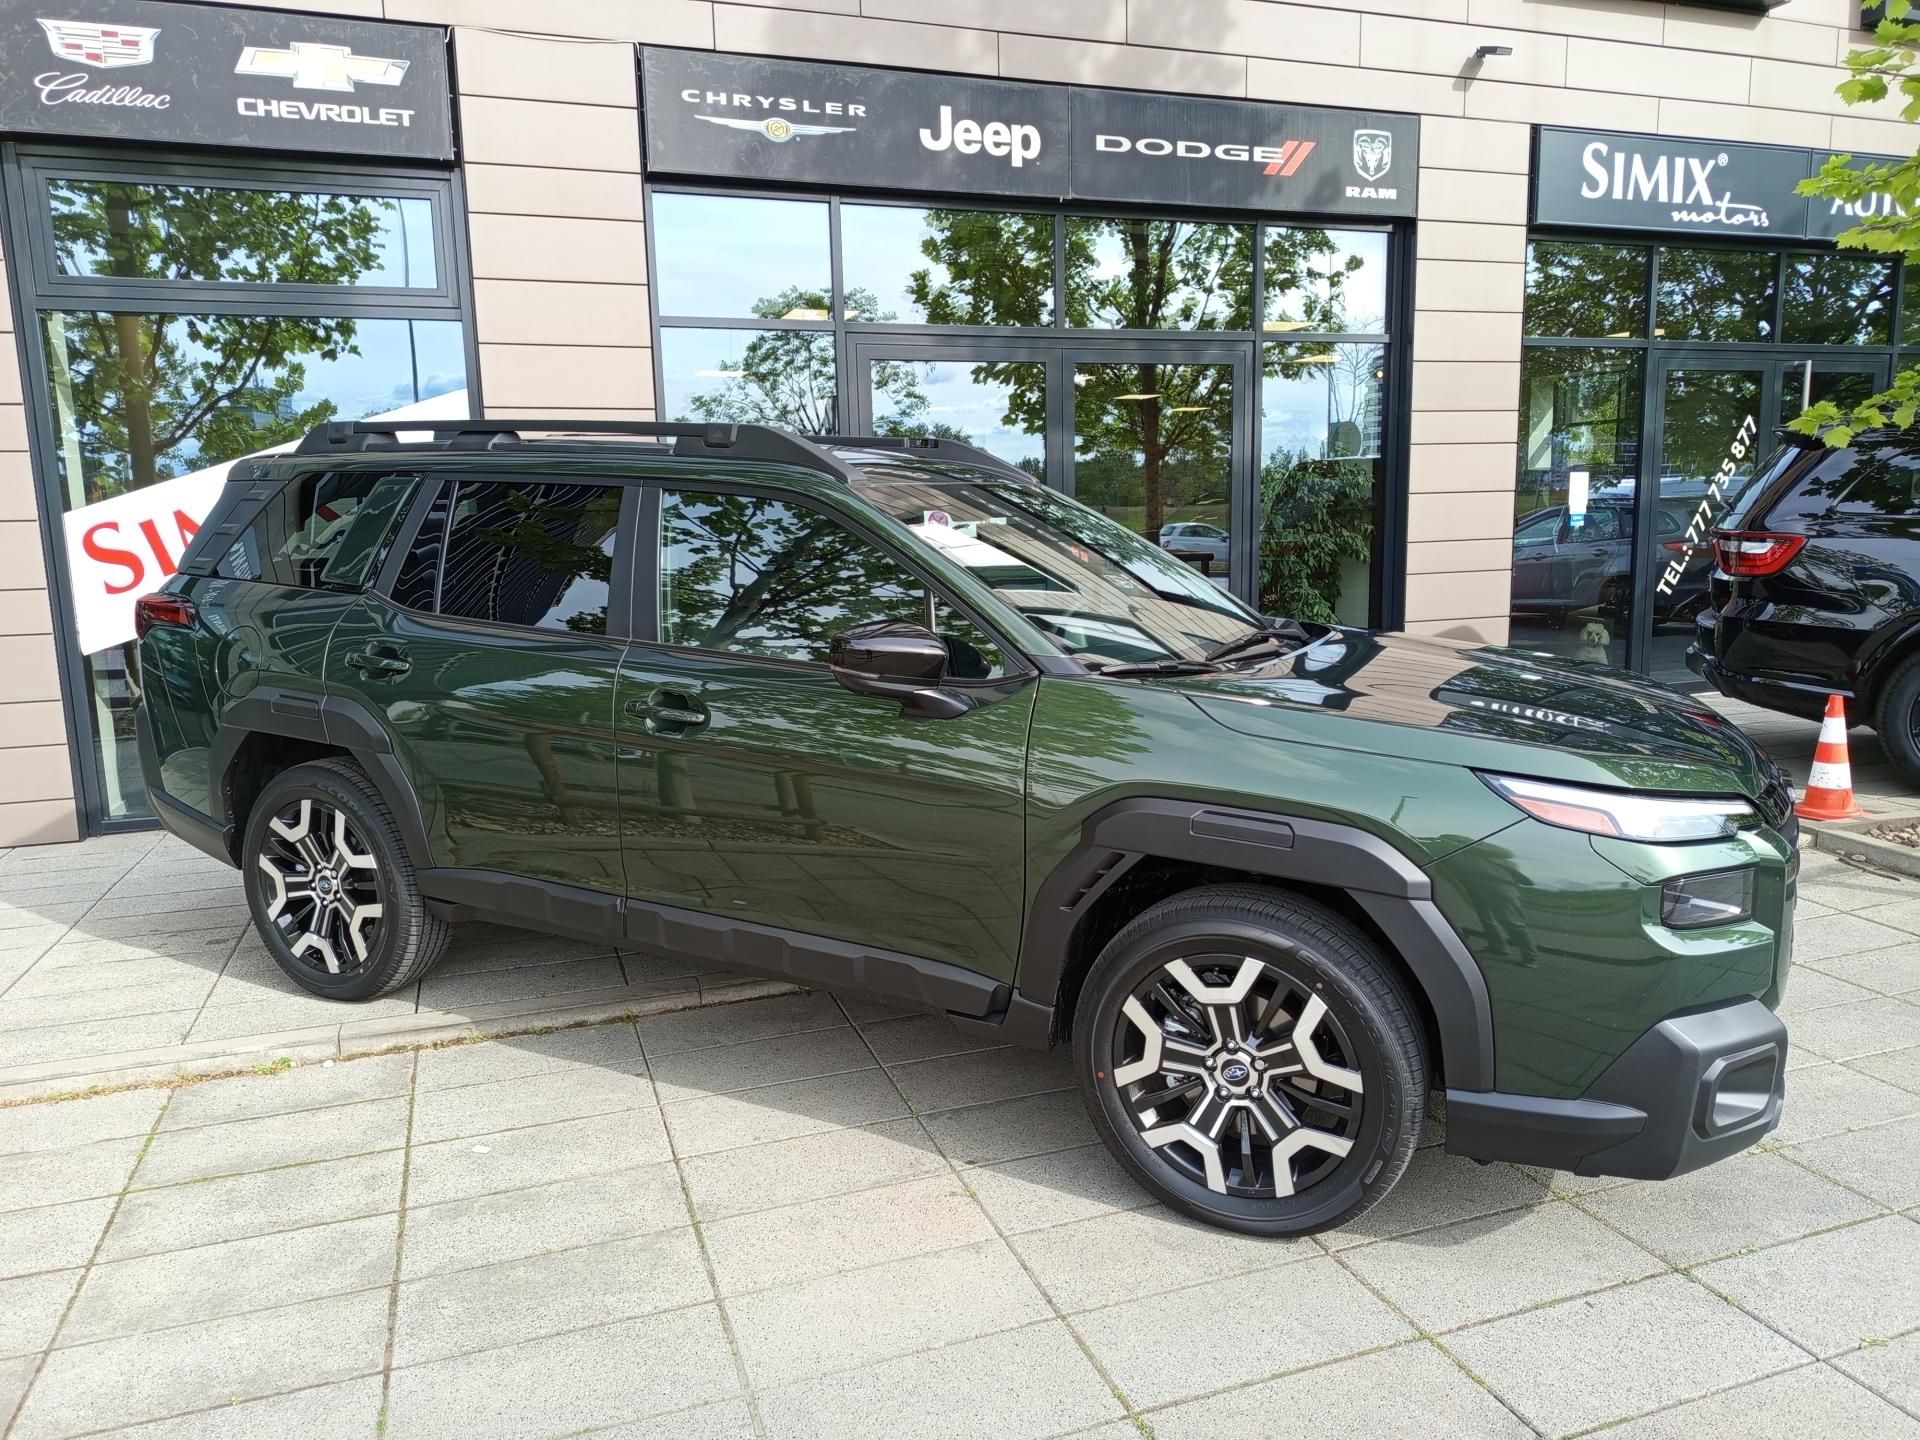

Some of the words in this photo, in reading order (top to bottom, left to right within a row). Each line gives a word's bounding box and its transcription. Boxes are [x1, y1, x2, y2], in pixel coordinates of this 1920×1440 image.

[33, 72, 171, 110] Cadillac
[681, 89, 867, 117] CHRYSLER
[237, 97, 415, 127] CHEVROLET
[919, 105, 1041, 168] Jeep
[1095, 134, 1284, 164] DODGE
[1345, 186, 1397, 200] RAM
[1671, 192, 1769, 228] motors
[1685, 500, 1712, 544] 777
[1708, 458, 1736, 501] 735
[1731, 414, 1757, 459] 877
